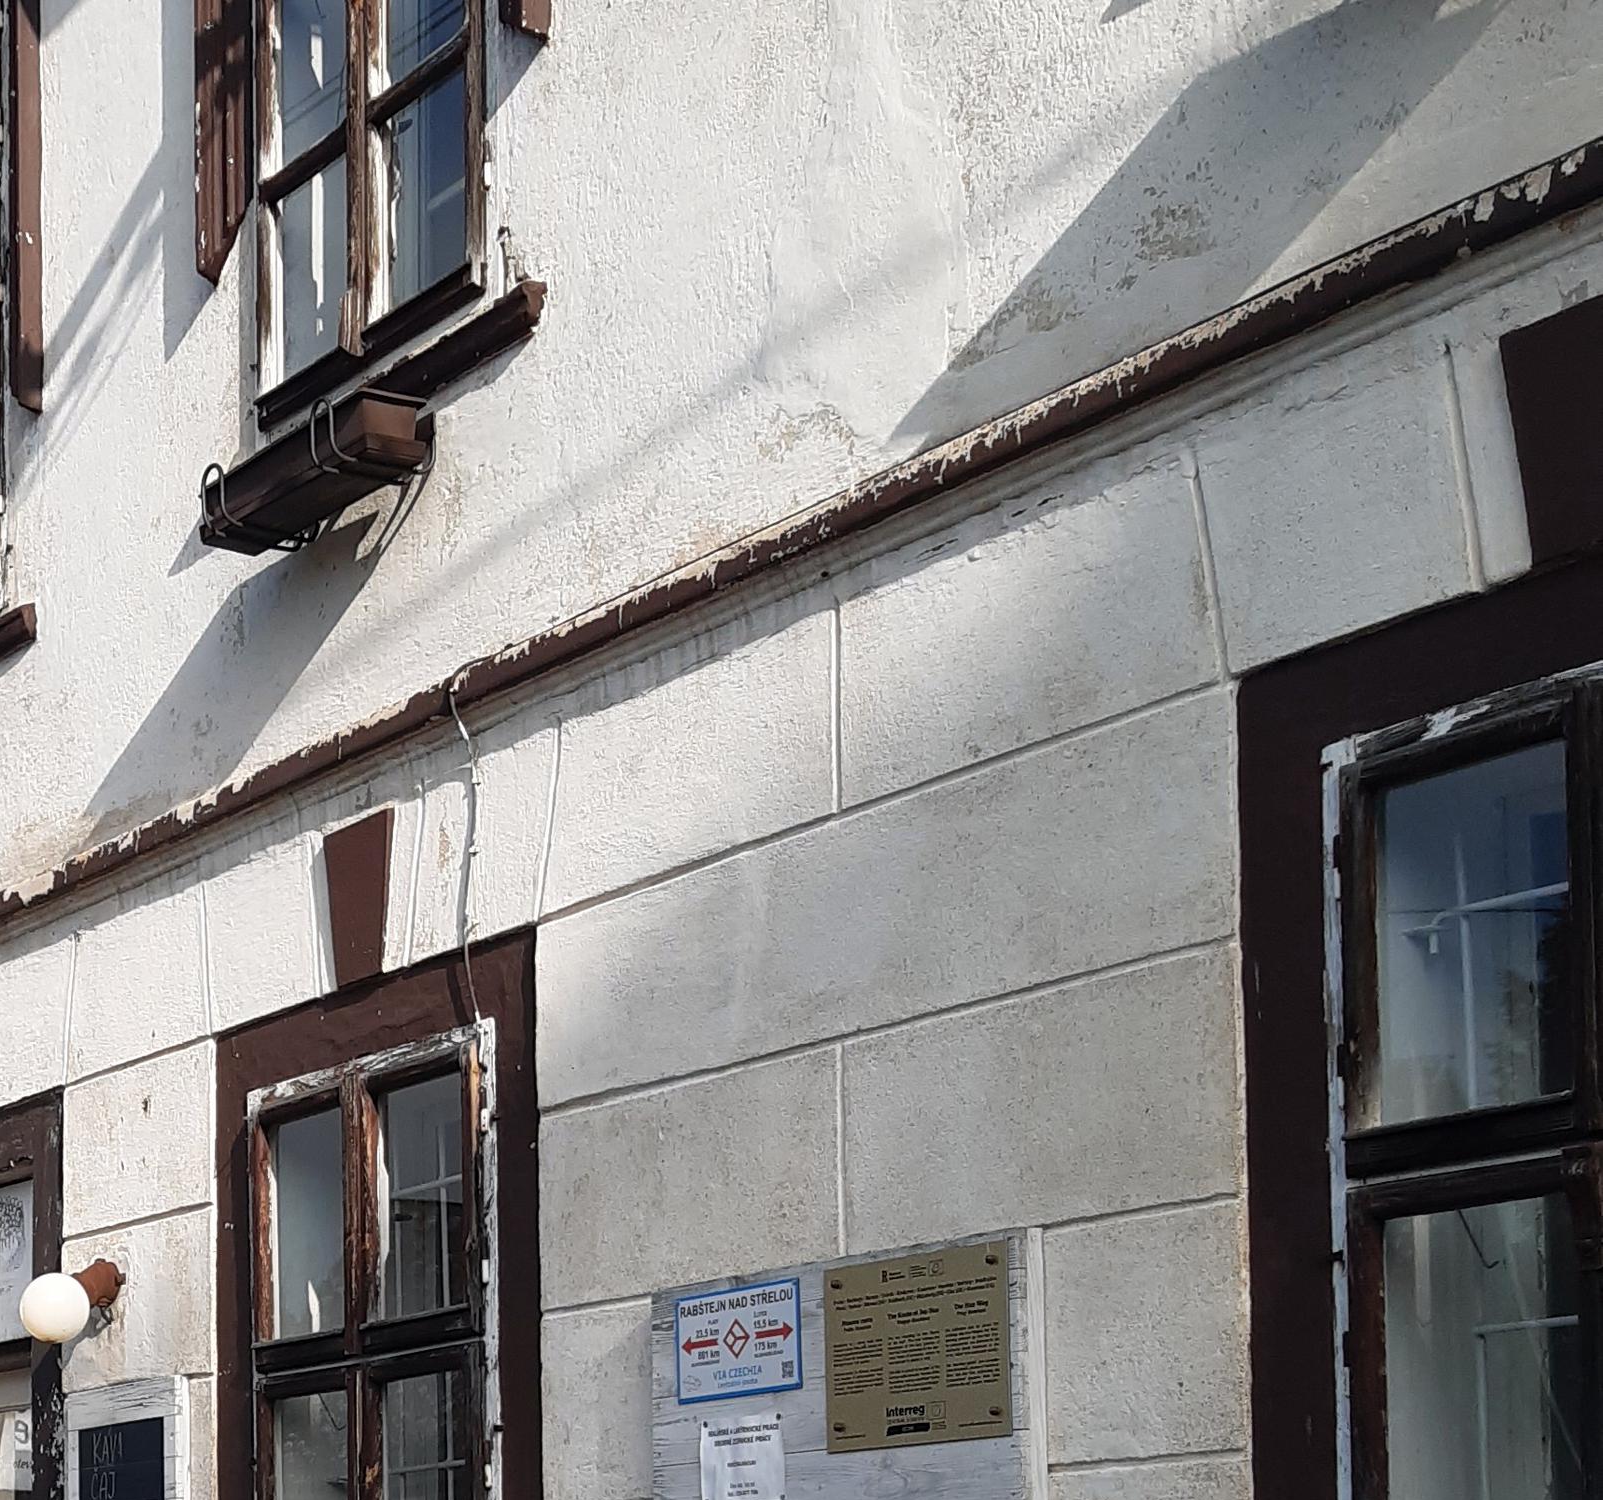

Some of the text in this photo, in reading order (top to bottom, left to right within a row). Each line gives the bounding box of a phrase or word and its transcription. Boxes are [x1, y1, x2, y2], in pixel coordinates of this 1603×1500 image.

[680, 1288, 794, 1318] RABŠTEJN NAD STŘELOU
[713, 1365, 763, 1380] VIA CZECHIA
[886, 1405, 925, 1417] Interreg
[90, 1467, 116, 1500] ČAJ
